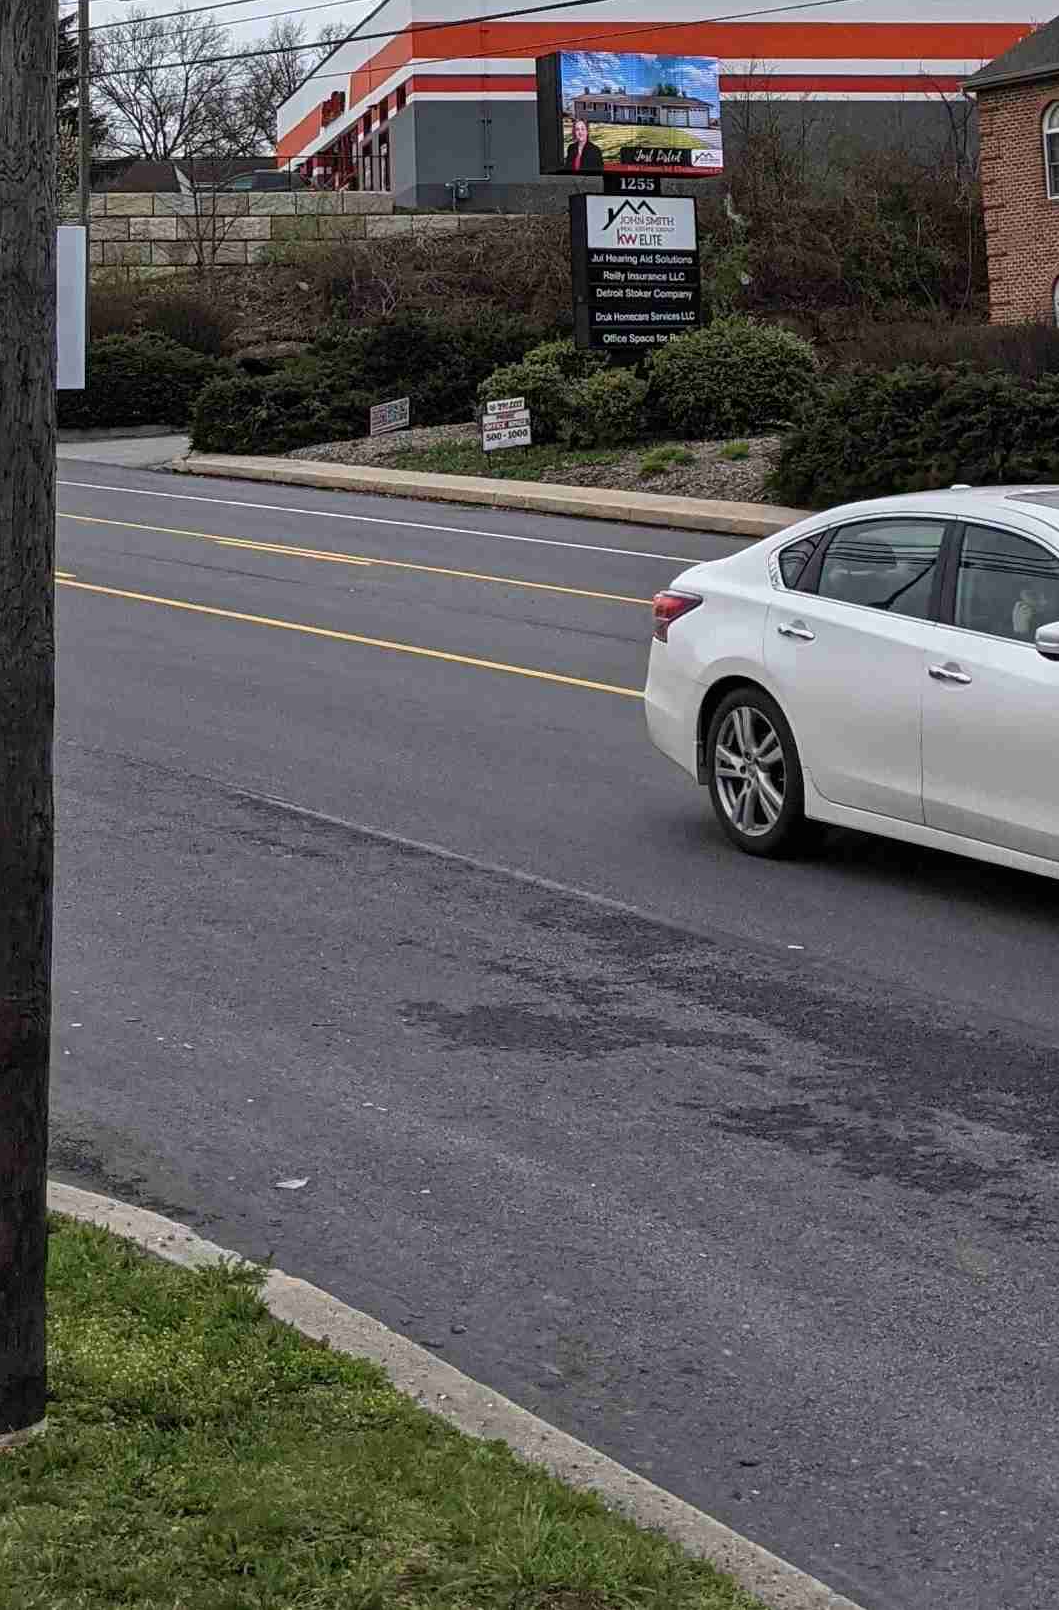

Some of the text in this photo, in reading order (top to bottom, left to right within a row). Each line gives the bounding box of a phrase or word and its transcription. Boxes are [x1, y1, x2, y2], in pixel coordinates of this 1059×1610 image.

[620, 177, 655, 190] 1255
[620, 215, 675, 227] JOHN SMITH
[639, 234, 663, 246] ELITE
[605, 254, 638, 265] Hearing
[639, 254, 653, 264] Aid
[654, 255, 693, 265] Solutions
[627, 272, 667, 281] Insurance
[668, 272, 685, 281] LLC
[596, 288, 693, 301] Detroit Stoker Company
[650, 312, 680, 321] Services
[681, 311, 695, 321] LLC
[603, 334, 628, 344] Office
[629, 334, 655, 344] Space
[656, 334, 668, 343] for
